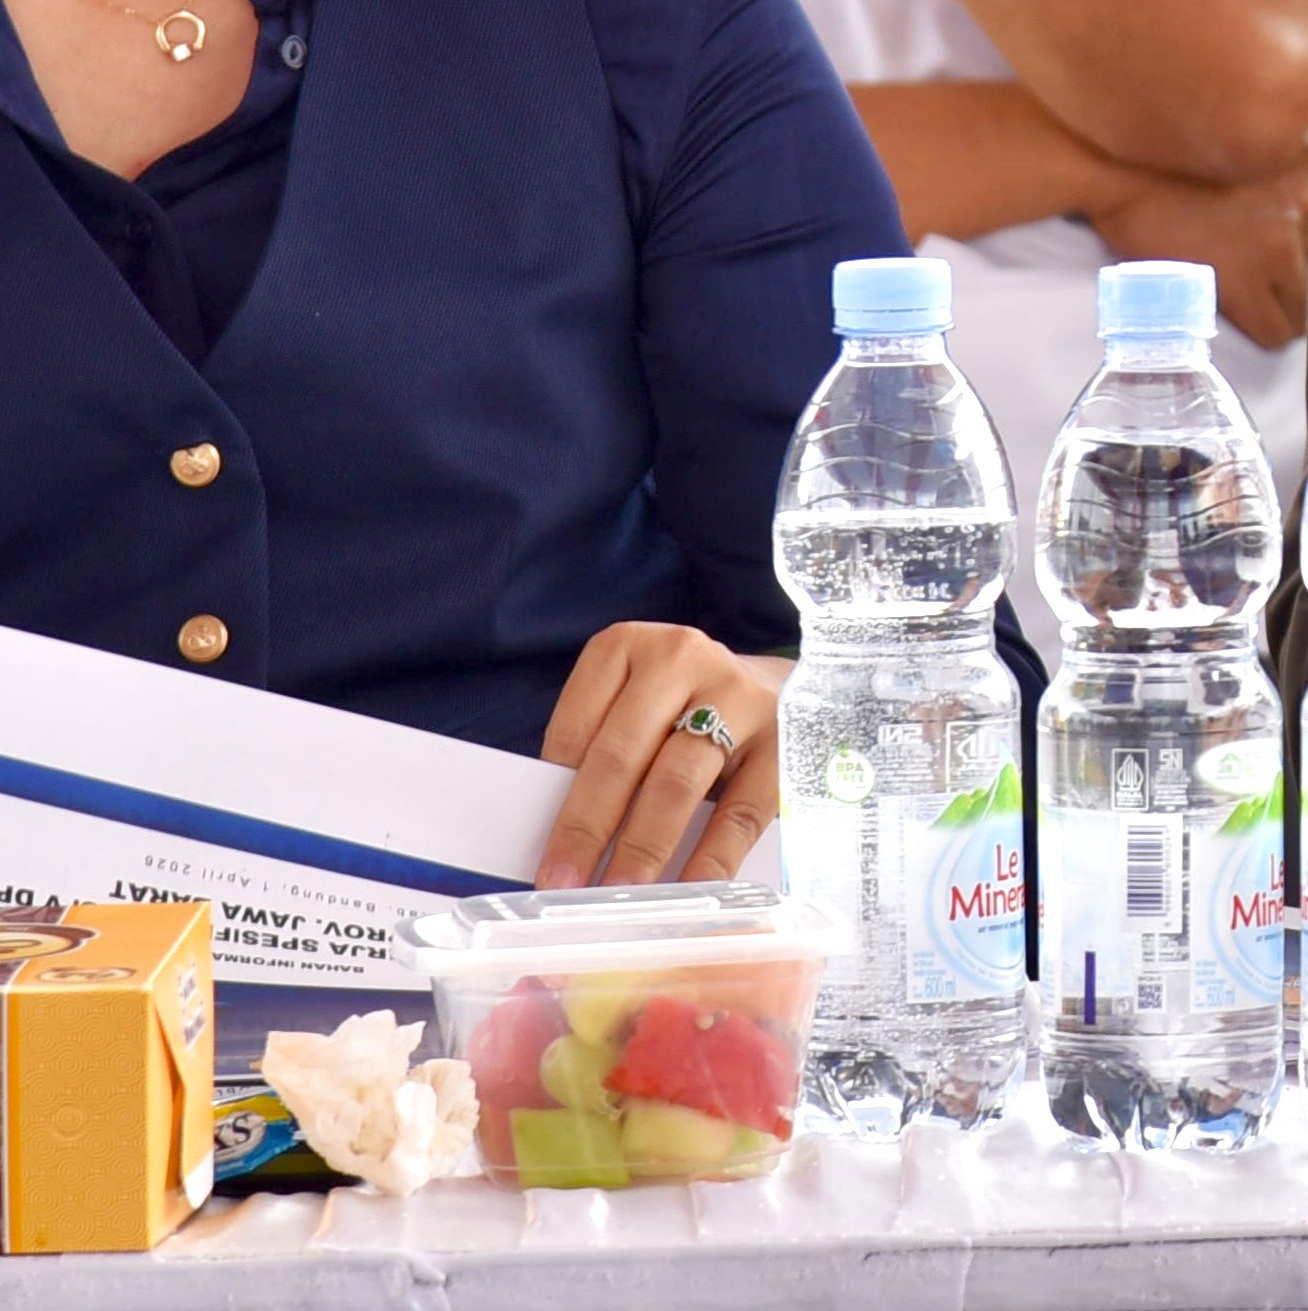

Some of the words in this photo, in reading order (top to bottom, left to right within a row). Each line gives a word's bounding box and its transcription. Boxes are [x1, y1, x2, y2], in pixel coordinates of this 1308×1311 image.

[836, 762, 864, 772] BPA
[144, 855, 191, 876] 2026
[996, 843, 1018, 881] Le
[202, 867, 250, 890] April
[281, 883, 376, 912] Bandung,
[221, 900, 306, 930] JAWA
[211, 925, 319, 953] SPESIF
[314, 918, 394, 943] ROV.
[301, 962, 365, 974] BAHAN
